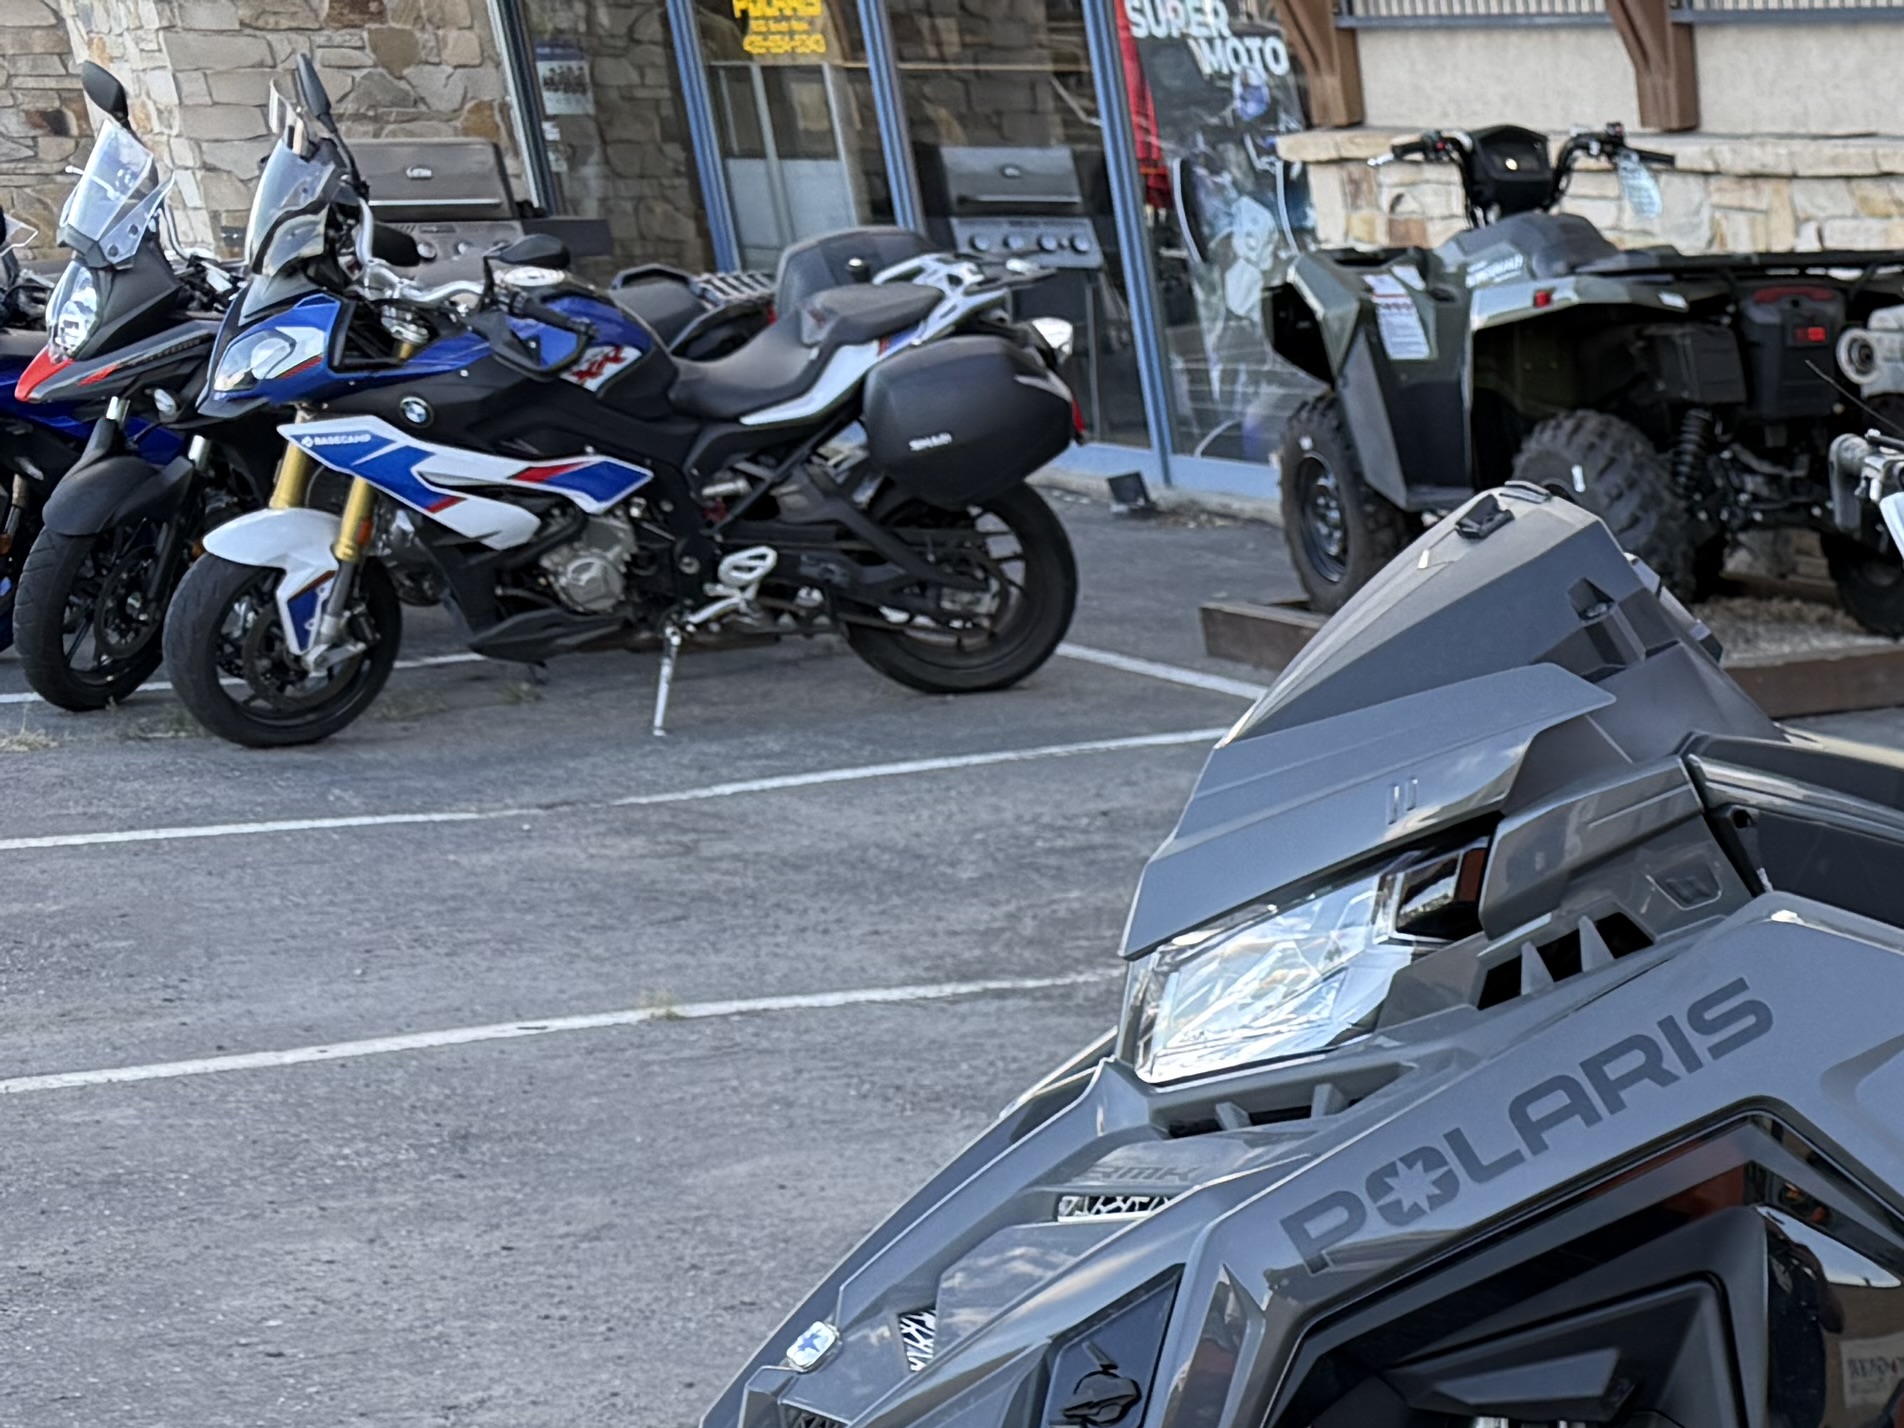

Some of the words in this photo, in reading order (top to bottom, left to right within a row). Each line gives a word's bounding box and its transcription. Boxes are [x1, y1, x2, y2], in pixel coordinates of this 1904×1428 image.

[1124, 0, 1232, 38] SUPER
[1187, 36, 1291, 78] MOTO
[1279, 976, 1774, 1276] POLARIS
